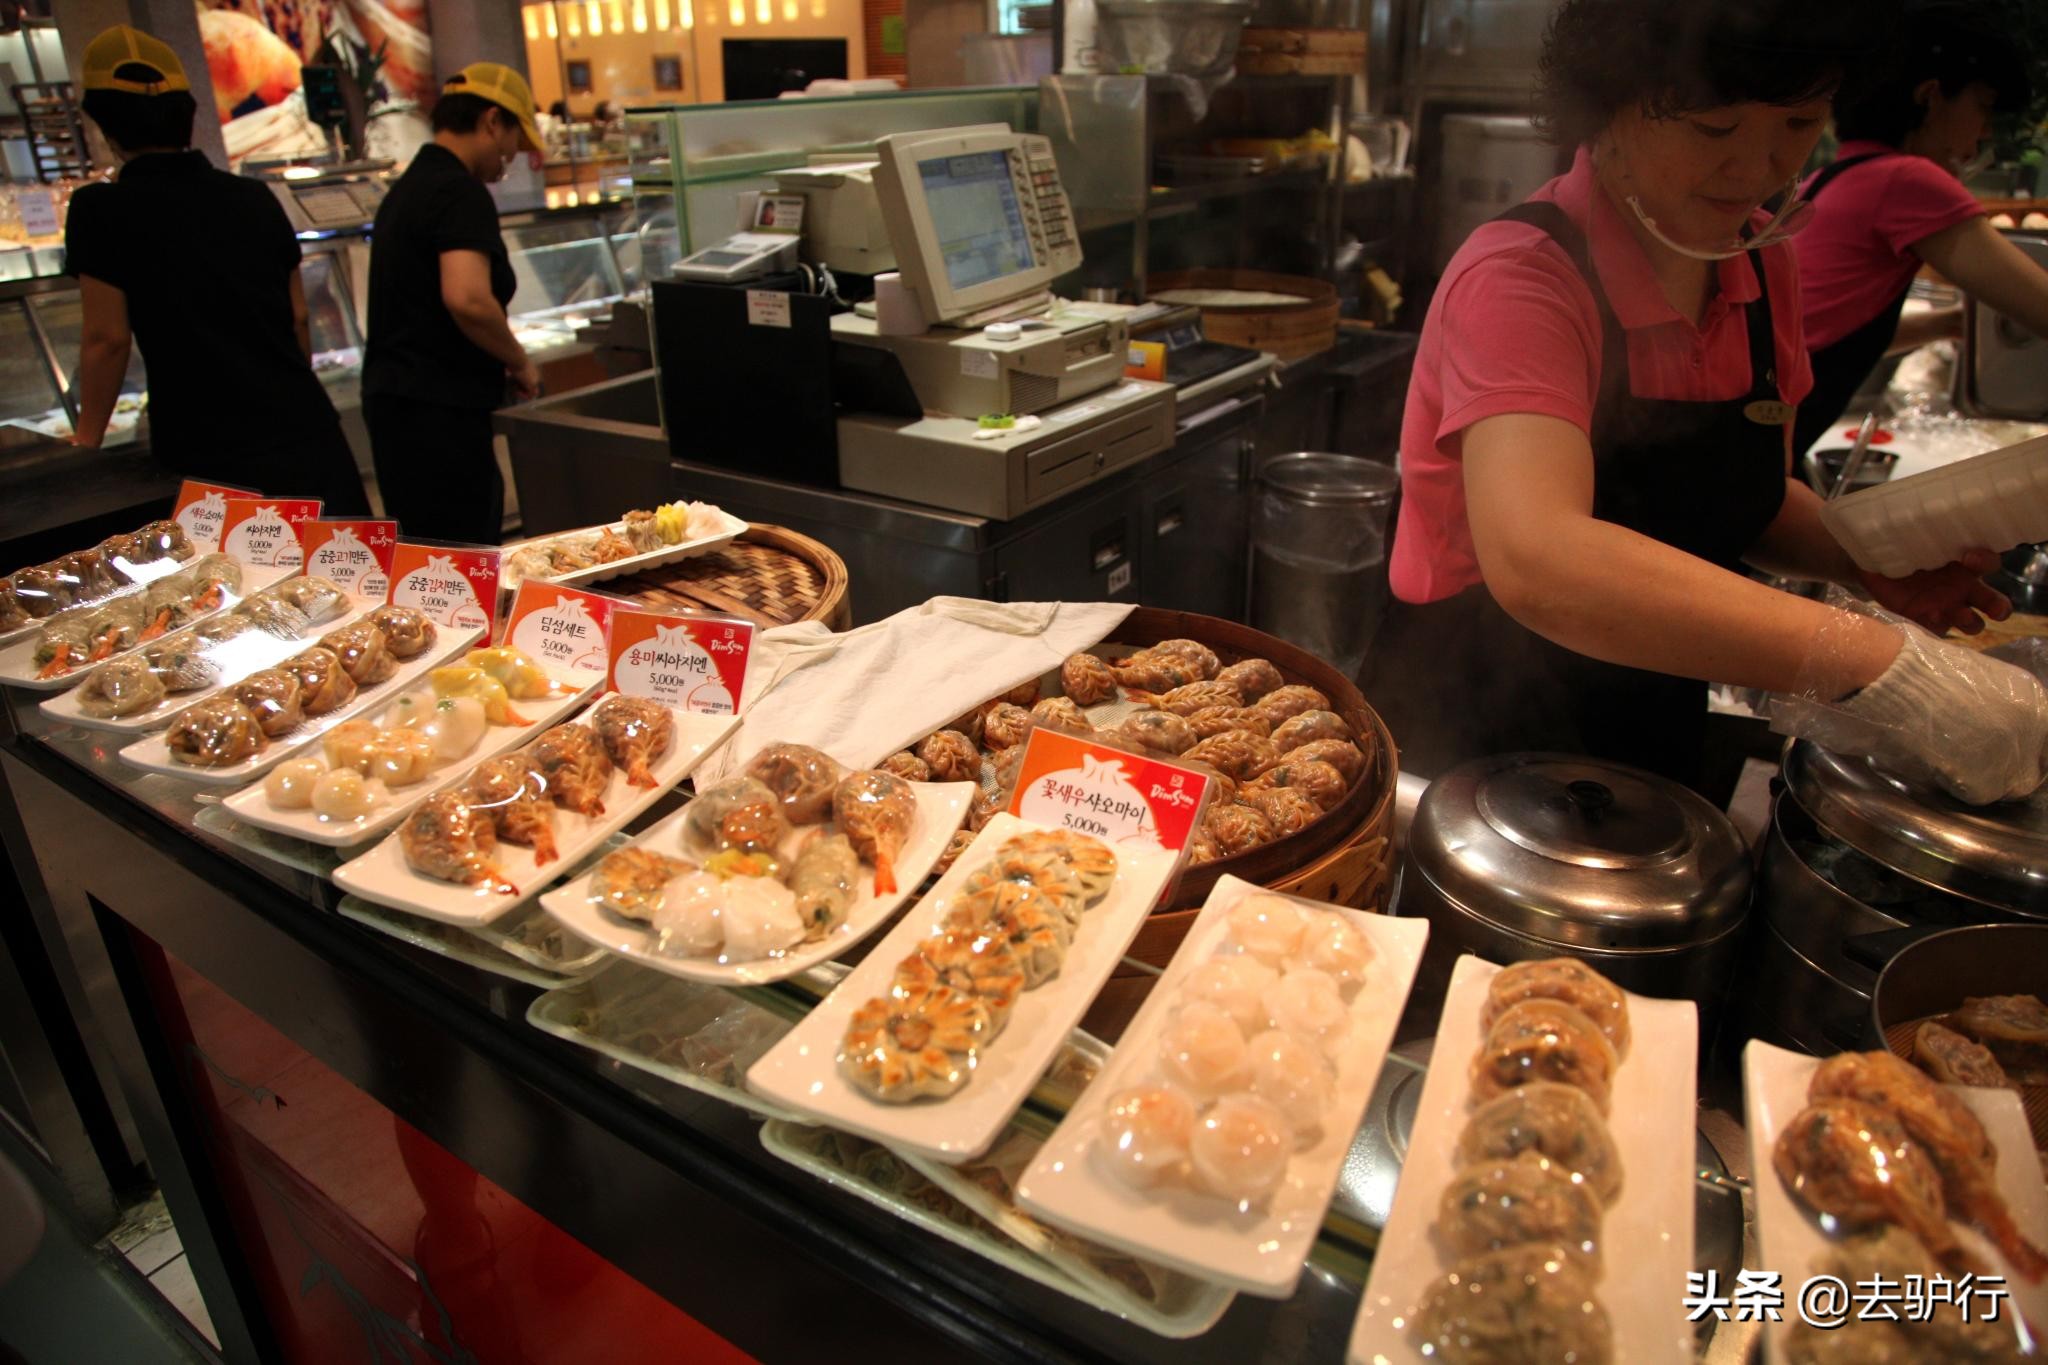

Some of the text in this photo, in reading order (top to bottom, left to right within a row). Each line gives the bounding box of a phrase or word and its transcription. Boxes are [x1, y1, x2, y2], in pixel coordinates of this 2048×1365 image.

[319, 550, 369, 565] 궁중고기만두
[469, 567, 495, 580] DimSum
[408, 576, 467, 596] 궁중김치만두
[541, 616, 586, 640] 딤섬세트
[711, 639, 744, 655] DimSum
[628, 648, 707, 674] 용미씨아지엔
[1041, 778, 1146, 825] 꽃새우샤오마이
[1150, 784, 1195, 807] DimSum
